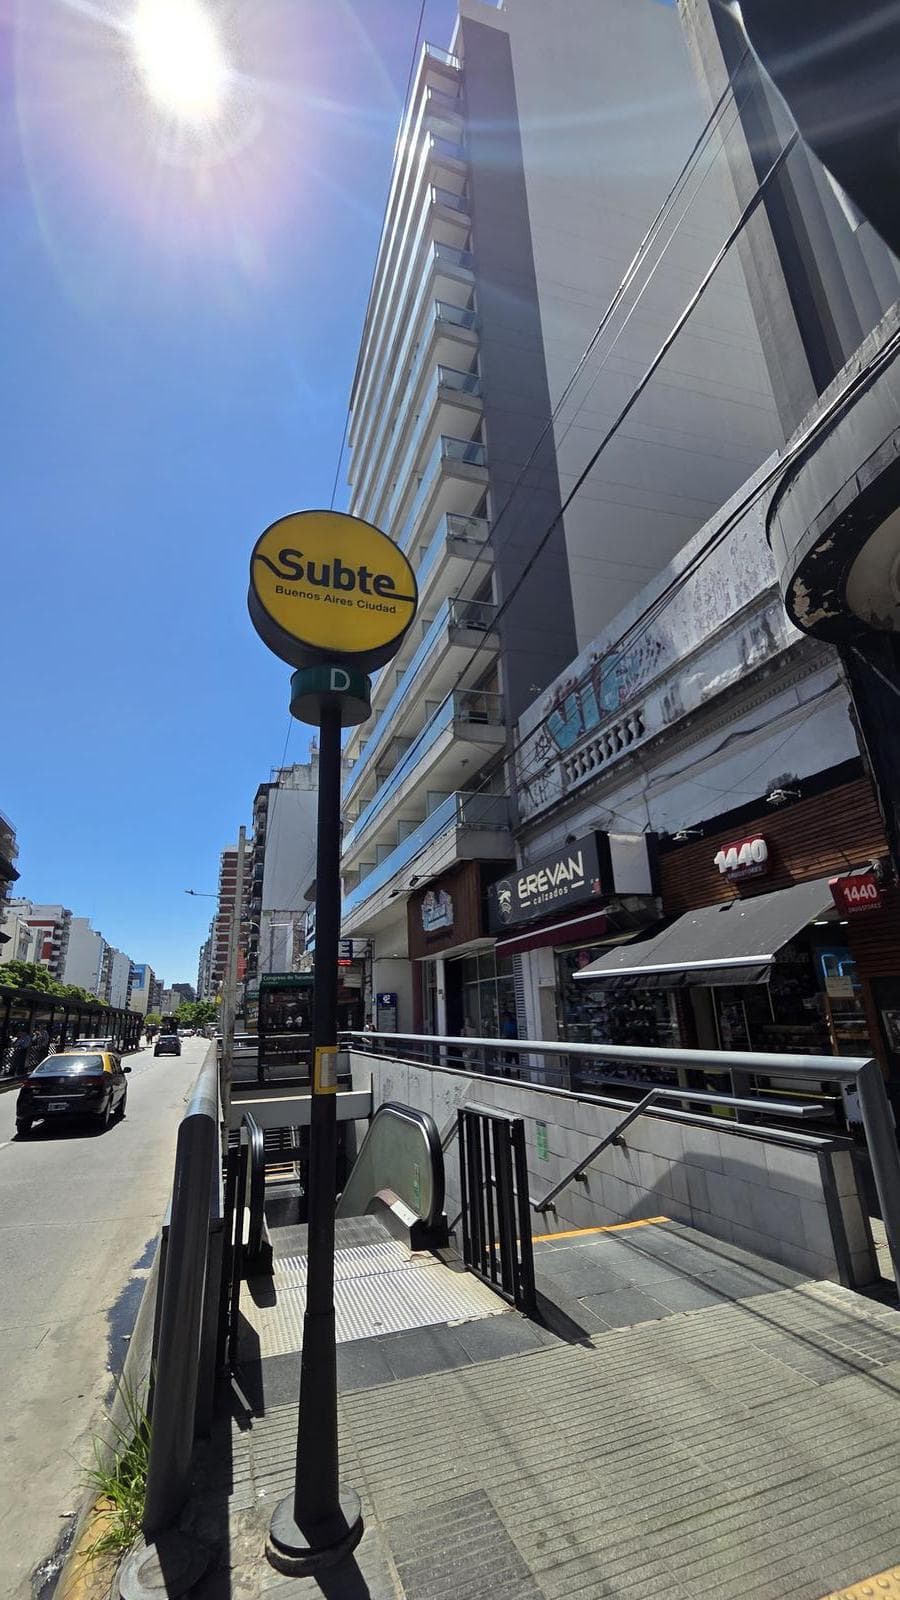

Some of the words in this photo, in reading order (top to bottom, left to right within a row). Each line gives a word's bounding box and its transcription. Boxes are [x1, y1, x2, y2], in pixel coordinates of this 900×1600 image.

[255, 548, 415, 602] Subte
[275, 585, 321, 601] Buenos
[323, 593, 353, 607] Aires
[356, 599, 397, 614] Ciudad
[330, 667, 350, 691] D
[714, 839, 768, 874] 1440
[518, 850, 584, 899] EREVAN
[533, 886, 568, 905] calzados
[843, 883, 877, 902] 1440
